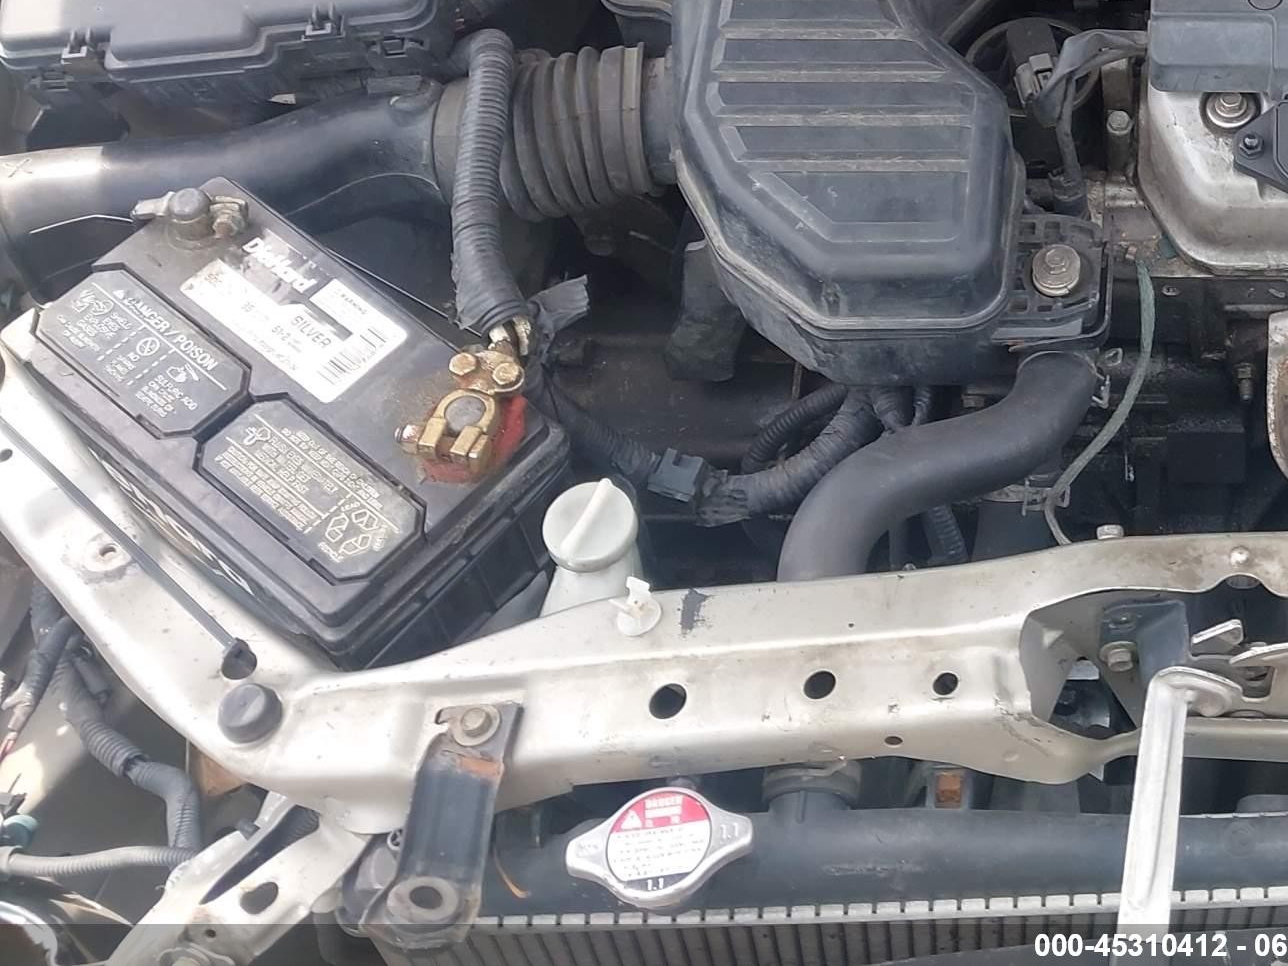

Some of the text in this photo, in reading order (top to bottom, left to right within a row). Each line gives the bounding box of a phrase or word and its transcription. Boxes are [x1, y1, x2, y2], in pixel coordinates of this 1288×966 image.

[241, 236, 317, 293] DieHard
[290, 315, 331, 348] SILVER
[172, 334, 217, 370] POISON
[720, 822, 740, 840] 1.1
[646, 877, 664, 891] 1.1
